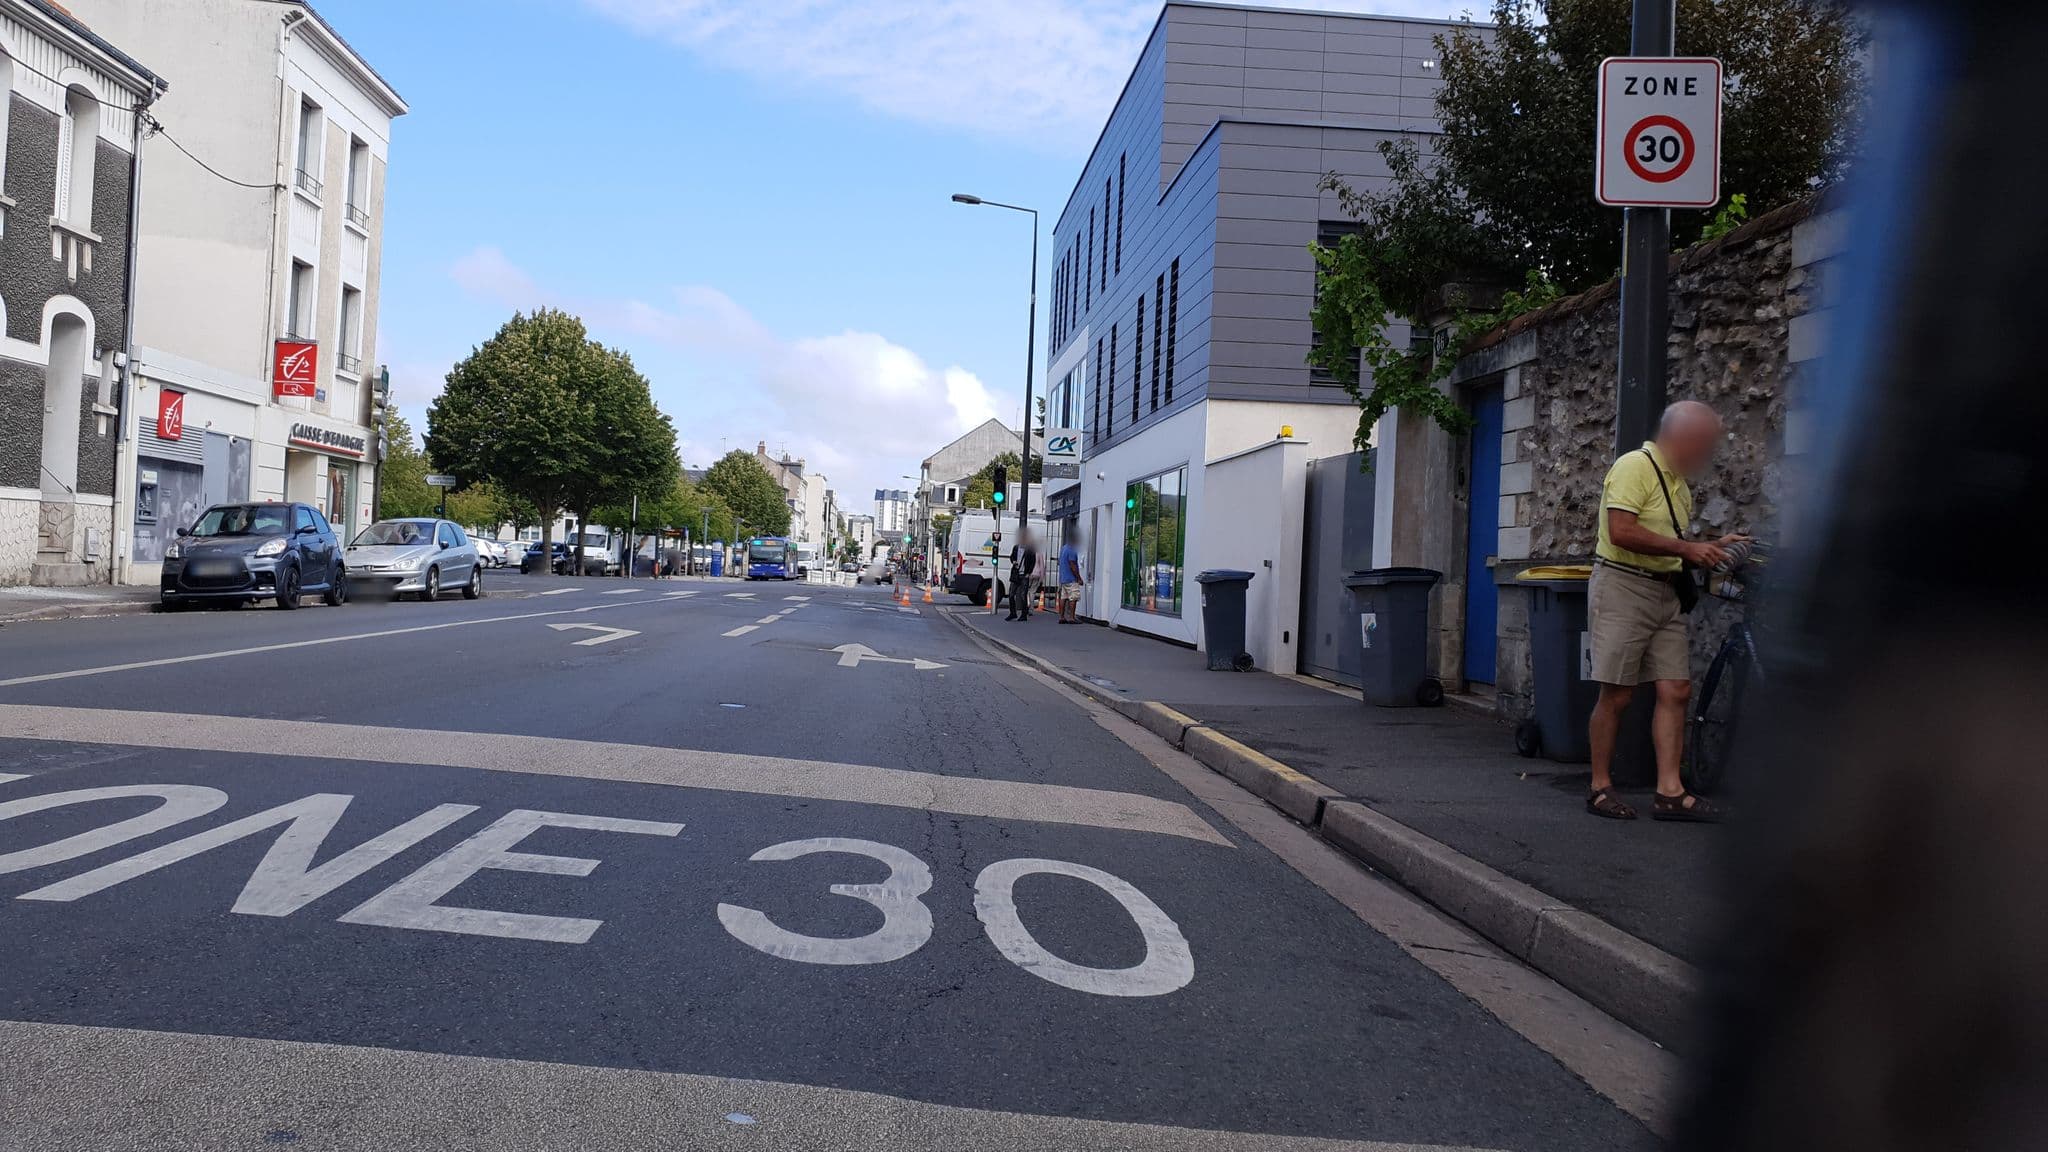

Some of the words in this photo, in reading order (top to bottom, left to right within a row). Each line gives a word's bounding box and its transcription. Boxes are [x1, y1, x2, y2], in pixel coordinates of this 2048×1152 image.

[1624, 76, 1698, 96] ZONE
[1638, 135, 1681, 163] 30
[292, 422, 322, 442] CAISSE
[1048, 436, 1077, 452] CA
[0, 773, 686, 944] ONE
[717, 837, 1195, 997] 30
